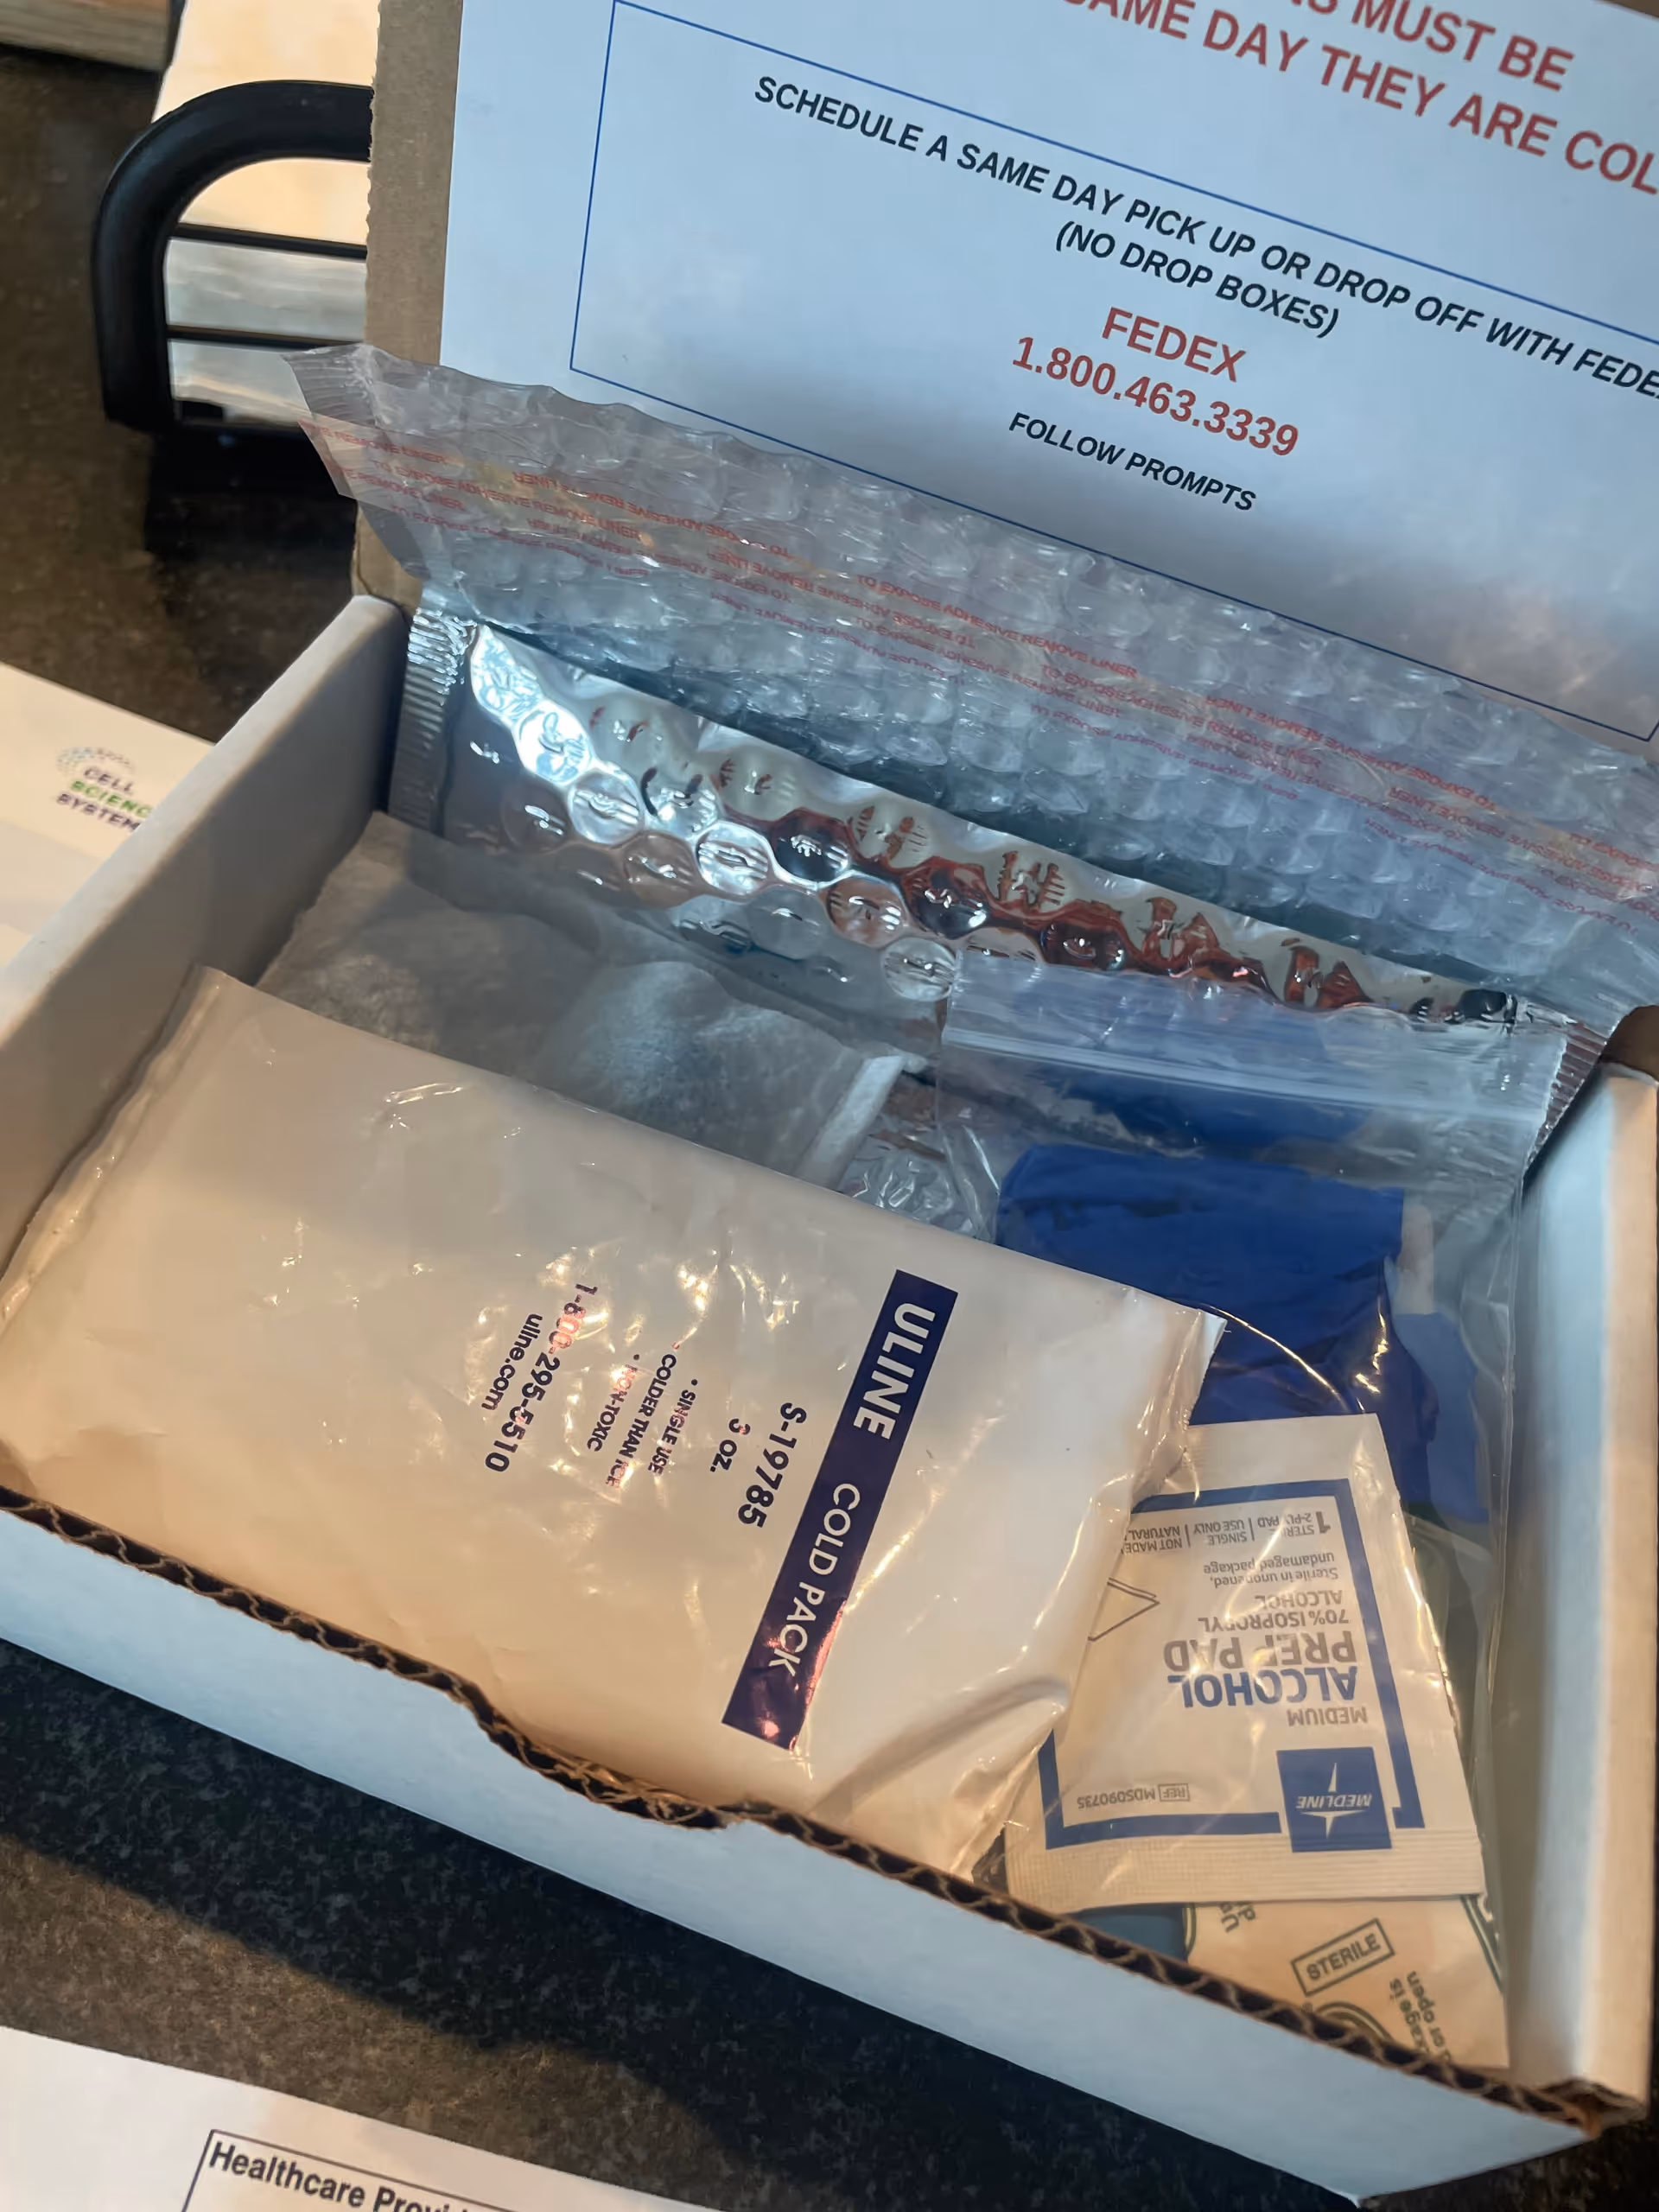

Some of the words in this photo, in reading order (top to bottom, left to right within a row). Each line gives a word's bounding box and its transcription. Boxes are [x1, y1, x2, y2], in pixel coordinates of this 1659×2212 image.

[1351, 0, 1496, 62] MUST
[1497, 35, 1575, 92] BE
[1203, 10, 1308, 72] DAY
[1320, 44, 1446, 118] THEY
[1449, 92, 1558, 158] ARE
[1565, 129, 1658, 195] COL
[754, 76, 923, 152] SCHEDULE
[926, 135, 949, 162] A
[957, 143, 1050, 194] SAME
[1052, 175, 1124, 216] DAY
[1124, 199, 1206, 245] PICK
[1209, 226, 1256, 259] UP
[1261, 245, 1312, 279] OR
[1313, 262, 1411, 309] DROP
[1414, 296, 1484, 332] OFF
[1486, 318, 1574, 365] WITH
[1573, 348, 1659, 399] FEDE
[1055, 219, 1116, 258] (NO
[1121, 242, 1212, 289] DROP
[1216, 274, 1341, 340] BOXES)
[1101, 307, 1246, 383] FEDEX
[1012, 336, 1300, 456] 1.800.463.3339
[1008, 411, 1125, 466] FOLLOW
[1125, 453, 1257, 512] PROMPTS
[855, 574, 876, 588] TO
[880, 582, 942, 611] EXPOSE
[942, 603, 1019, 640] ADHESIVE
[1021, 632, 1087, 664] REMOVE
[1090, 654, 1137, 679] LINER
[84, 766, 133, 797] CELL
[485, 1283, 598, 1472] 1-800-295-5510
[639, 1352, 677, 1417] COLDER
[853, 1303, 936, 1440] ULINE
[586, 1362, 636, 1453] NON-TOXIC
[662, 1389, 696, 1445] SINGLE
[620, 1417, 648, 1459] THAN
[728, 1418, 751, 1436] 3
[606, 1459, 627, 1488] ICE
[647, 1446, 671, 1475] USE
[738, 1402, 807, 1528] S-19785
[809, 1483, 861, 1575] COLD
[1128, 1525, 1179, 1541] NATURAL
[1192, 1521, 1220, 1534] ONLY
[1223, 1519, 1244, 1531] USE
[1256, 1515, 1279, 1527] PAD
[1315, 1510, 1331, 1533] 1
[1124, 1540, 1156, 1553] MADE
[1159, 1538, 1181, 1550] NOT
[1207, 1531, 1246, 1545] SINGLE
[1203, 1557, 1255, 1575] package
[1259, 1549, 1333, 1571] undamaged
[1294, 1566, 1338, 1582] Sterile
[1279, 1571, 1292, 1583] in
[769, 1582, 825, 1676] PACK
[1308, 1607, 1349, 1625] 70%
[1162, 1637, 1242, 1673] PAD
[1167, 1665, 1357, 1708] ALCOHOL
[1286, 1706, 1367, 1727] MEDIUM
[1076, 1787, 1155, 1808] MDS090735
[1161, 1787, 1185, 1798] REF
[1294, 1791, 1372, 1811] MEDLINE
[1305, 1933, 1380, 1980] STERILE
[1388, 1977, 1404, 1998] is
[1406, 1968, 1438, 2024] open
[1429, 2026, 1444, 2048] or
[208, 2140, 365, 2209] Healthcare
